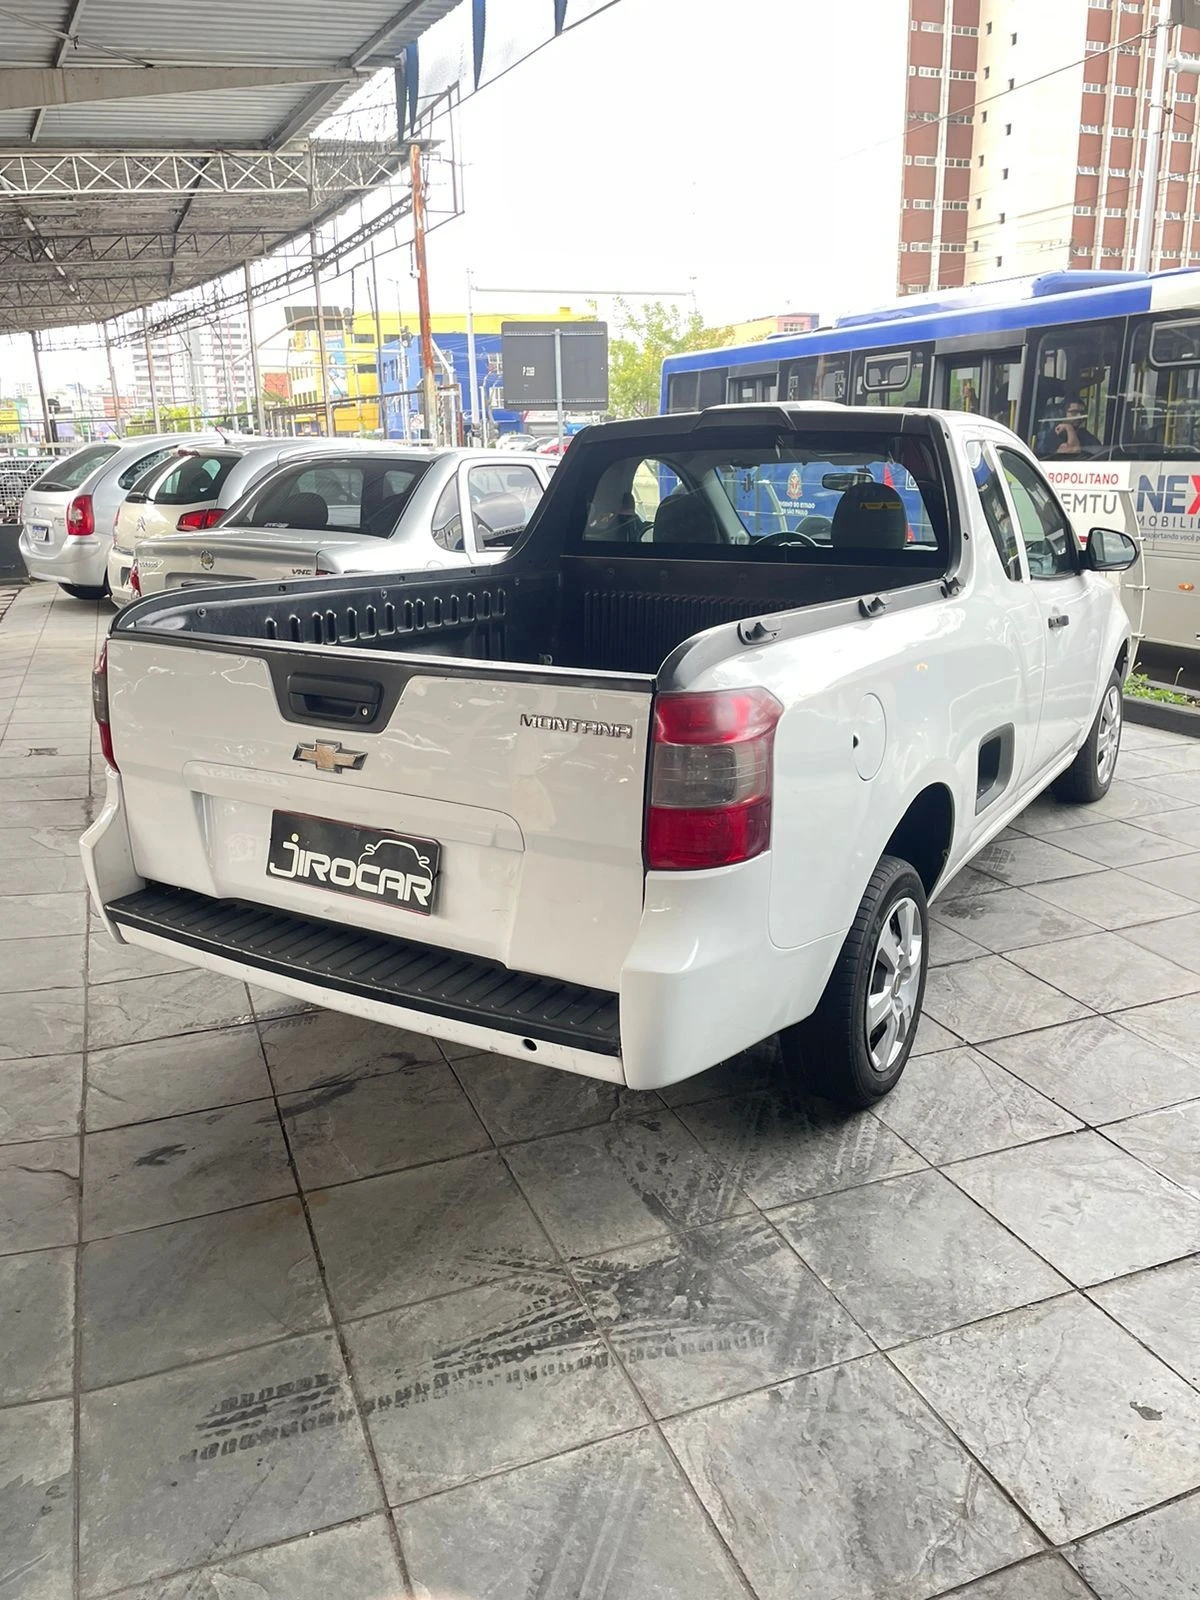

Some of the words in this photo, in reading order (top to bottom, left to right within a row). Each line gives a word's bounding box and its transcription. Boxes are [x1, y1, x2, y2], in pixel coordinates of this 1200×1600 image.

[1061, 493, 1118, 514] EMTU
[1137, 515, 1200, 529] MOBILI
[519, 713, 633, 739] MONTANA
